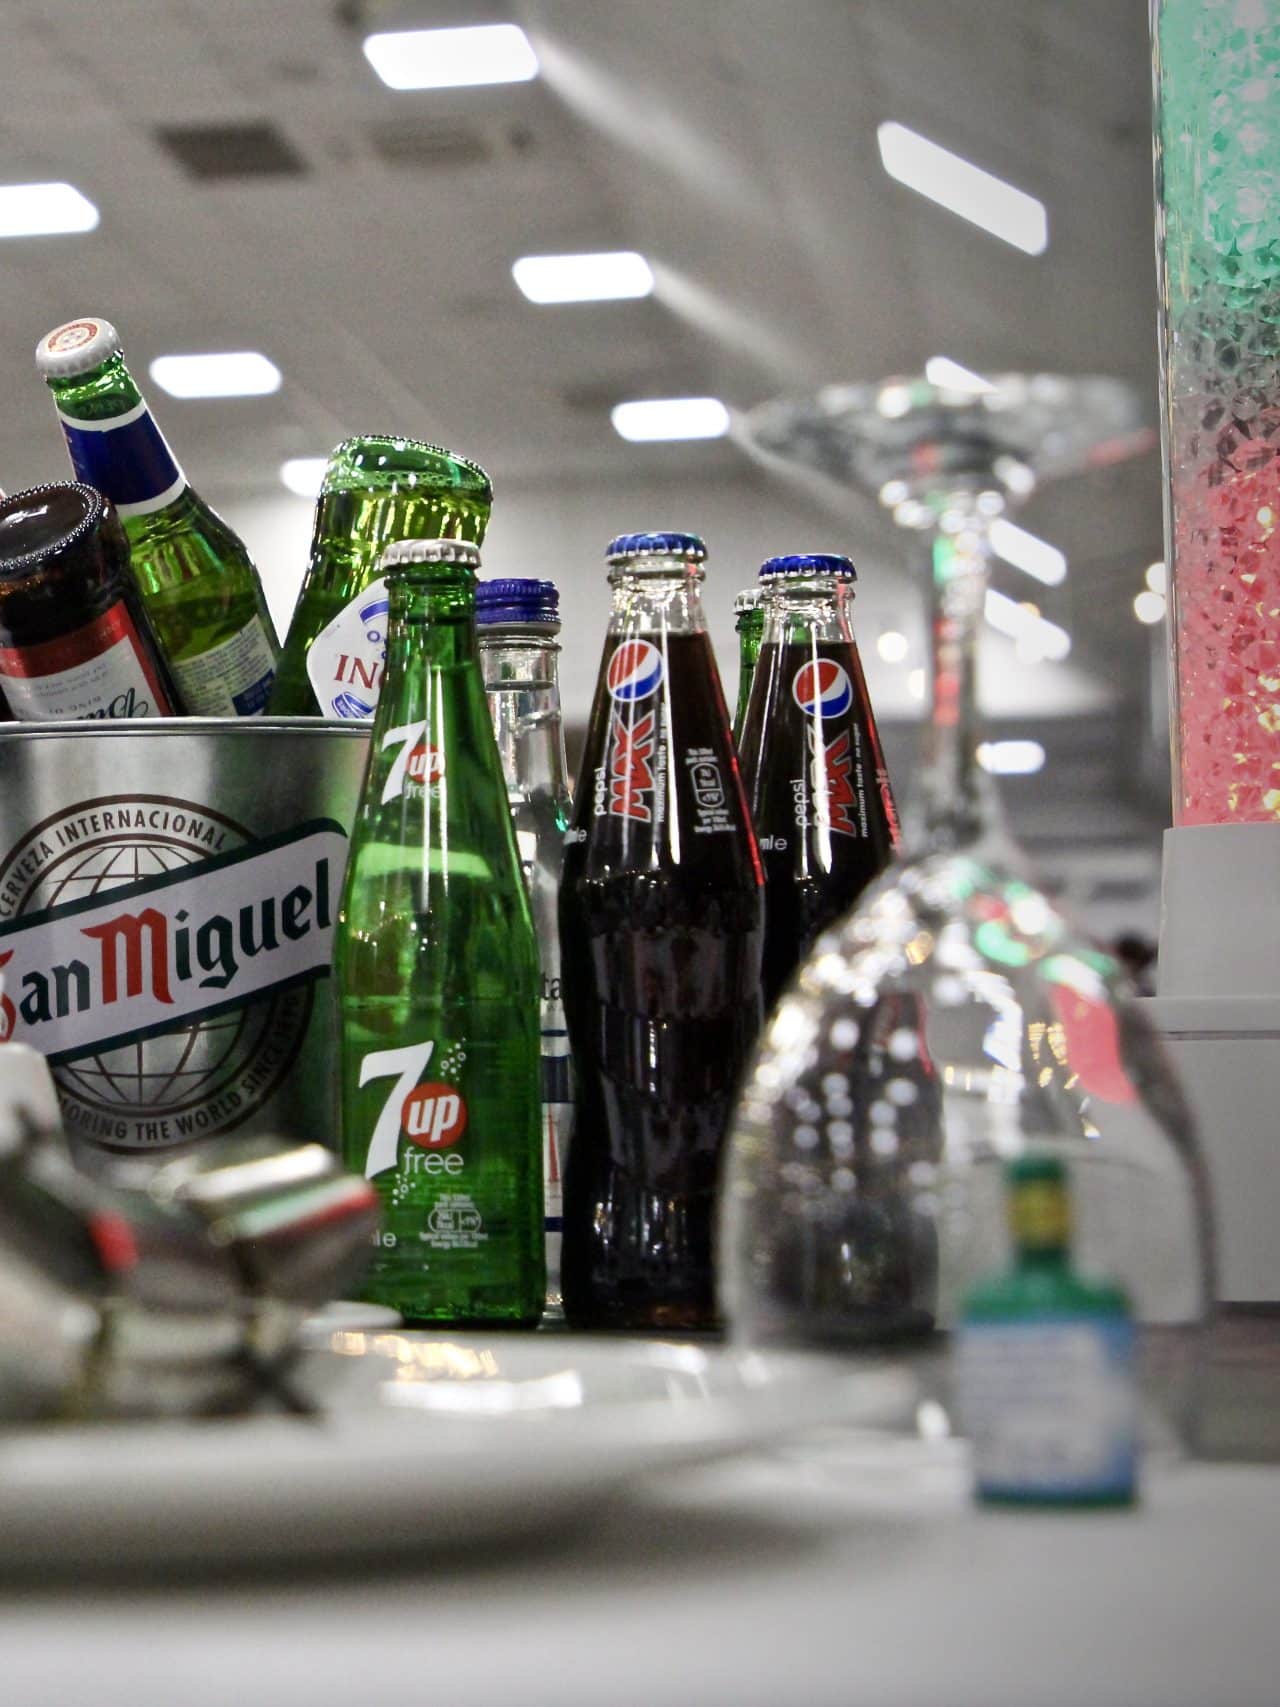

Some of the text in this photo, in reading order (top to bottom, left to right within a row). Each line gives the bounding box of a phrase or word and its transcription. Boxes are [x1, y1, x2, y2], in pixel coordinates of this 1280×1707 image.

[609, 705, 657, 823] MAX
[854, 763, 864, 787] taste
[594, 766, 608, 816] pepsi
[791, 779, 810, 827] pepsi
[858, 789, 869, 838] maximum
[56, 809, 227, 850] INTERNACIONAL
[80, 857, 333, 1004] Miguel
[135, 1122, 170, 1141] THE
[175, 1090, 242, 1136] WORLD
[404, 1147, 465, 1175] free
